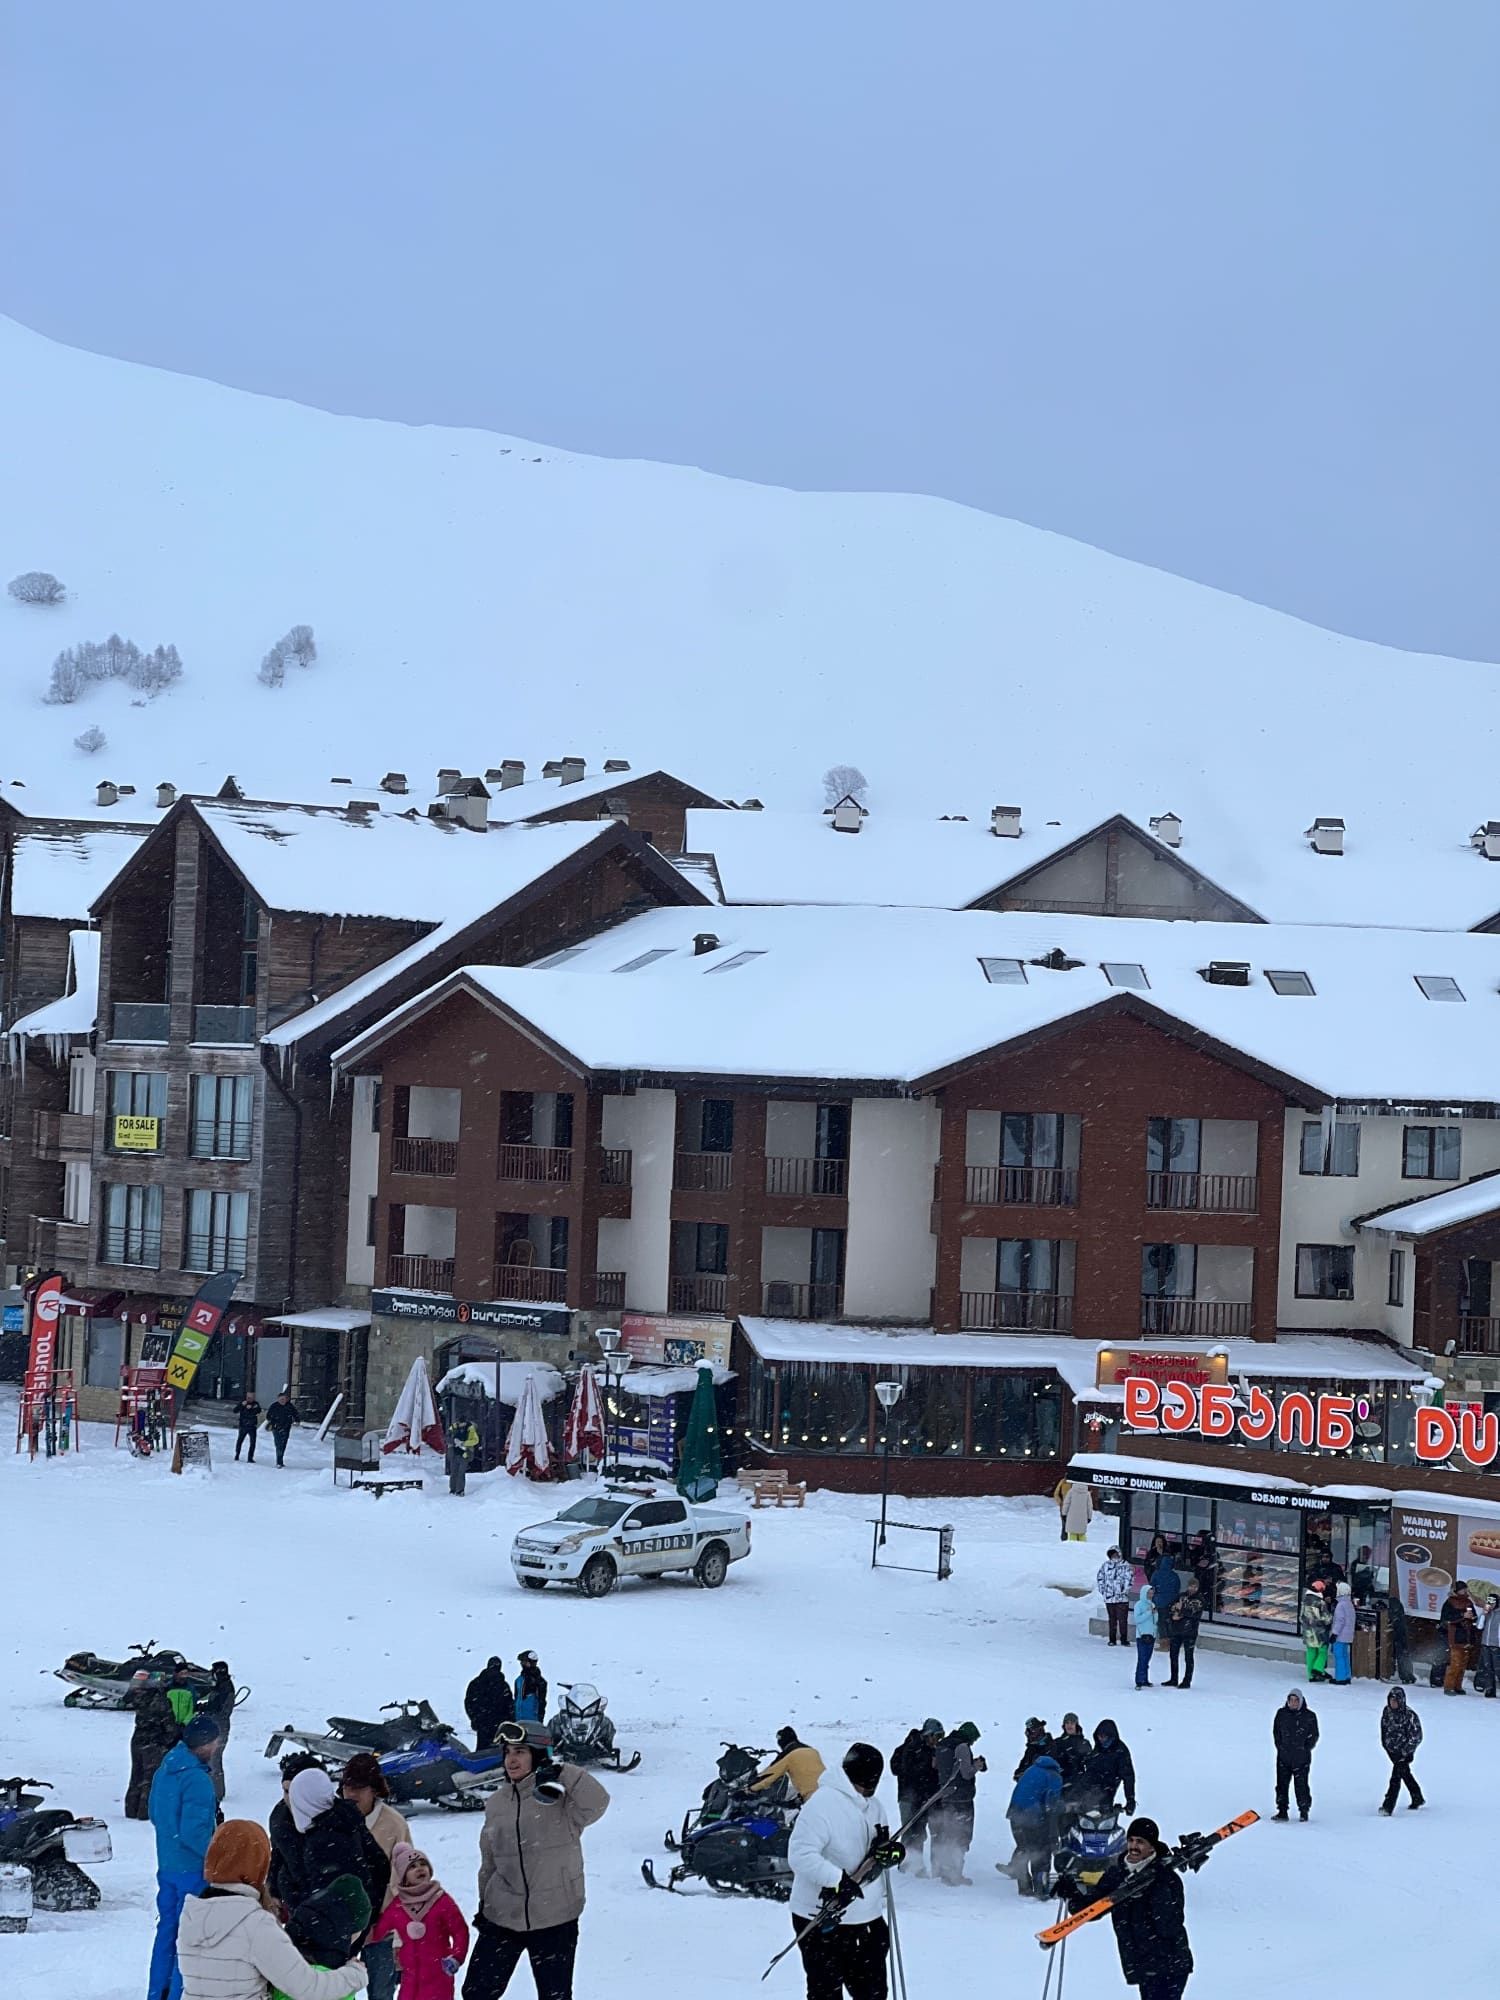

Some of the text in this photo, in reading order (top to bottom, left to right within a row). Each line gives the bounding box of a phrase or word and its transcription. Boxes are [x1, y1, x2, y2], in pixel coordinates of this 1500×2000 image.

[118, 1118, 155, 1130] FOR SALE
[471, 1307, 542, 1328] burusports
[1128, 1352, 1199, 1368] Restaurant
[1130, 1478, 1167, 1491] DUNKIN'
[1291, 1496, 1330, 1511] DUNKIN'
[1402, 1515, 1448, 1530] WARM UP
[1401, 1526, 1448, 1541] YOUR DAY
[624, 1535, 688, 1555] პოლიცია
